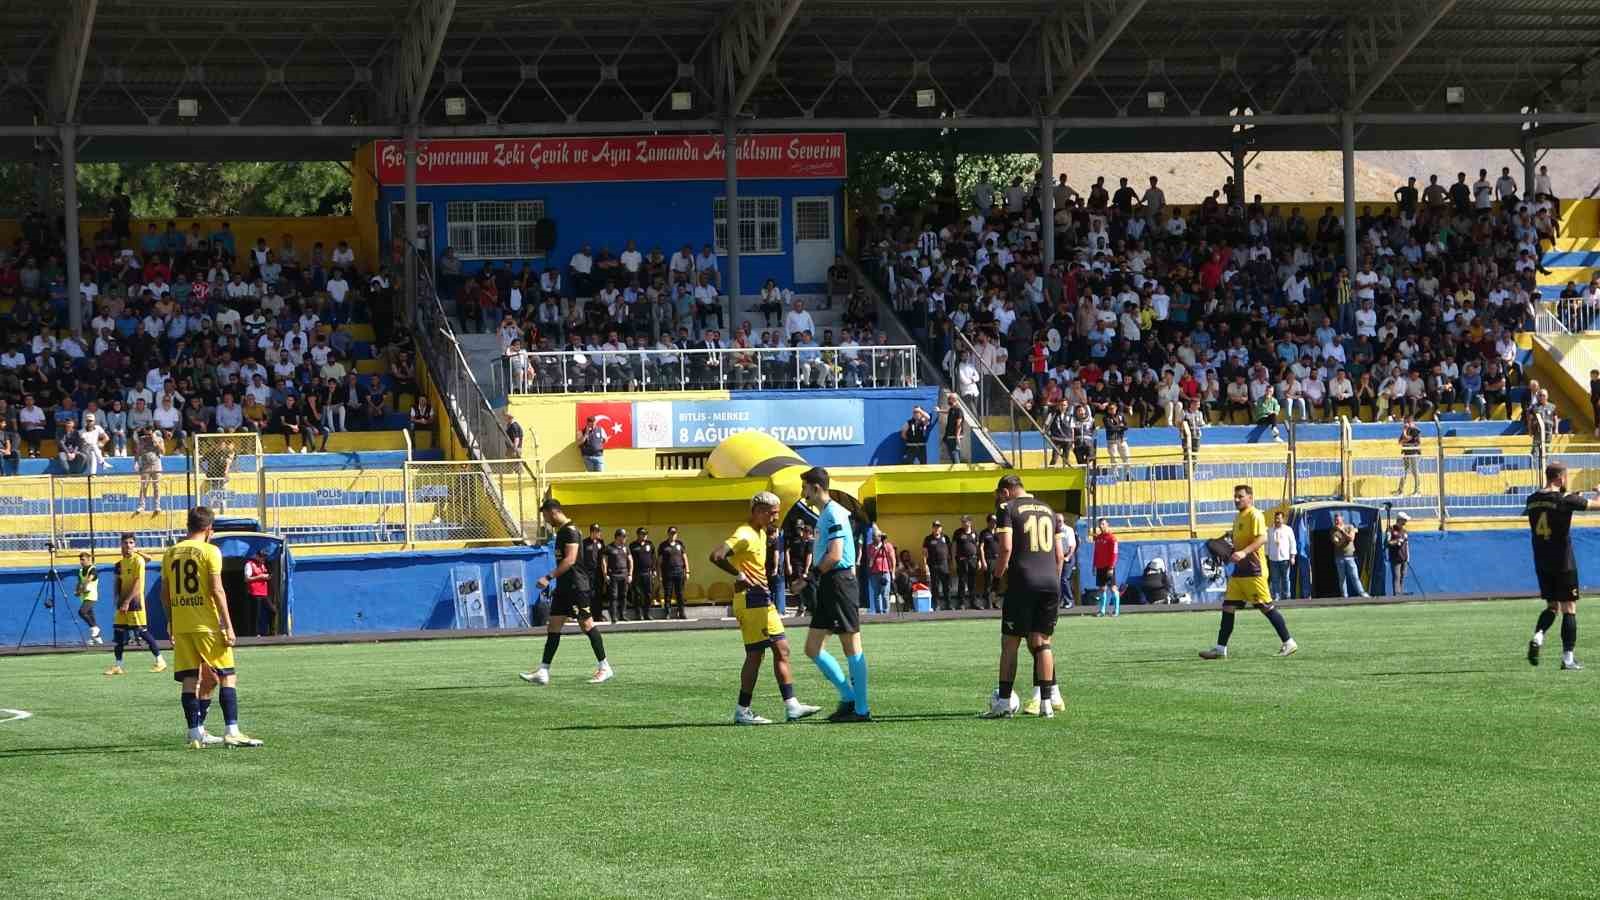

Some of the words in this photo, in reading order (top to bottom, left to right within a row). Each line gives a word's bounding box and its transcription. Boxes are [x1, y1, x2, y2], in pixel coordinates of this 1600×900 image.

[494, 143, 525, 168] Zeki
[530, 142, 569, 169] Çevik
[573, 149, 588, 163] ve
[592, 141, 630, 167] Aynı
[635, 140, 698, 164] Zamanda
[787, 138, 841, 161] Severim
[713, 411, 752, 421] MERKEZ
[680, 427, 689, 443] 8
[771, 425, 853, 441] STADYUMU
[1024, 515, 1053, 552] 10
[1536, 512, 1552, 540] 4
[171, 558, 200, 594] 18
